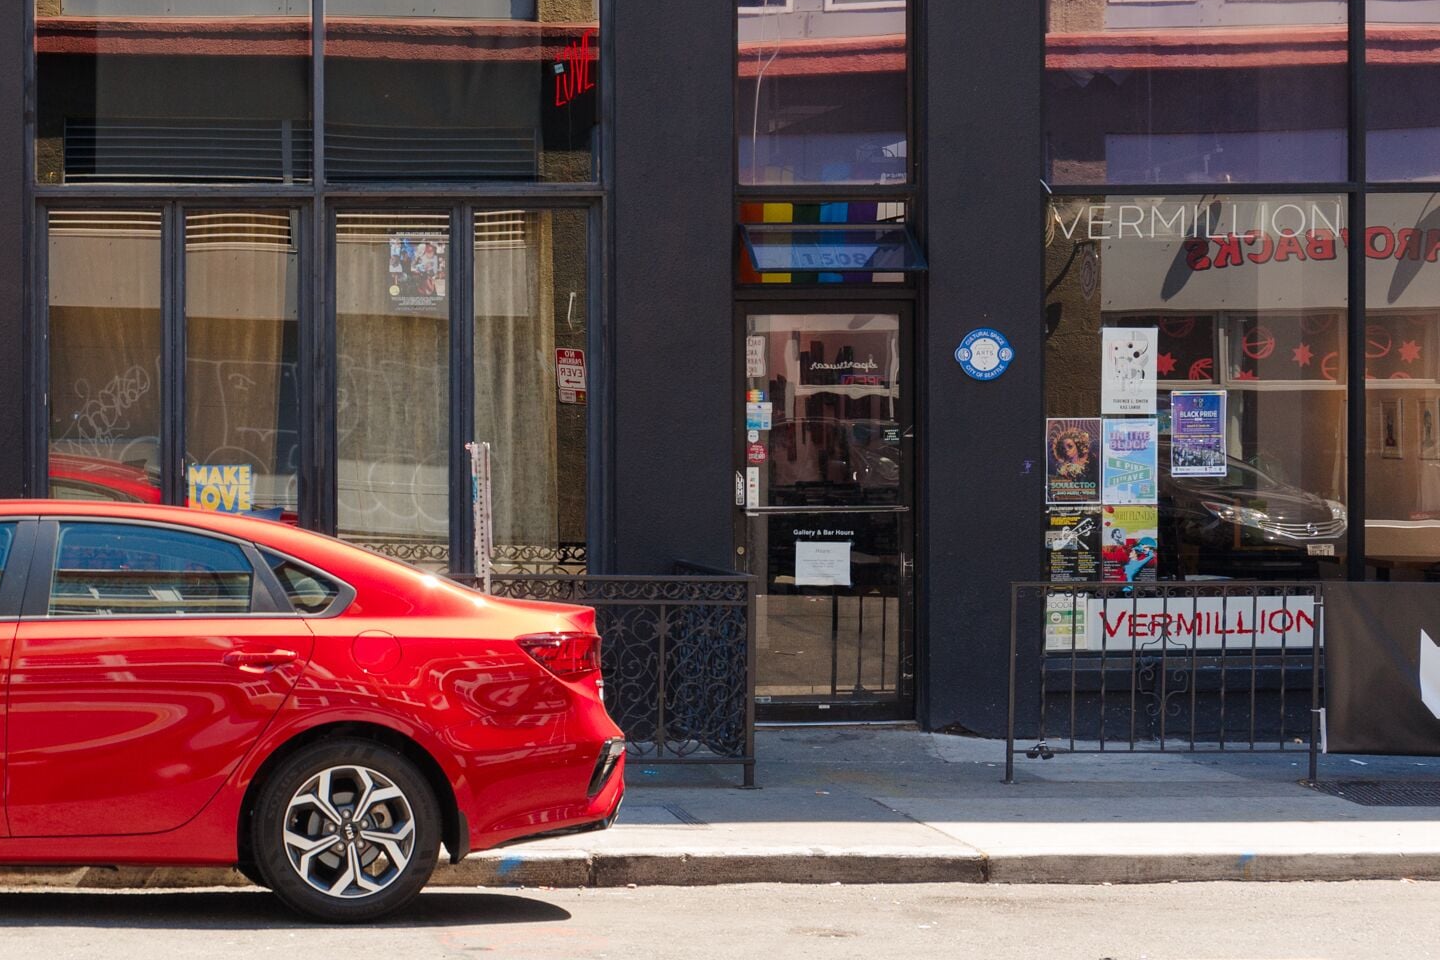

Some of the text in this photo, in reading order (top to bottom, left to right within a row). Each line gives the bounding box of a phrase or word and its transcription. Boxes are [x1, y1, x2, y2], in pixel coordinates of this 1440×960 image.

[555, 27, 597, 107] LOVE
[1052, 203, 1343, 241] VERMILLION
[965, 331, 1005, 346] CULTURAL SPACE
[984, 364, 1005, 379] SEATTLE
[1179, 410, 1218, 418] BLACK PRIDE
[1109, 440, 1149, 450] BLOCK
[190, 466, 250, 487] MAKE
[1127, 471, 1146, 482] AVE
[189, 485, 250, 511] LOVE
[792, 529, 816, 537] Gallery
[1098, 607, 1315, 638] VERMILLION
